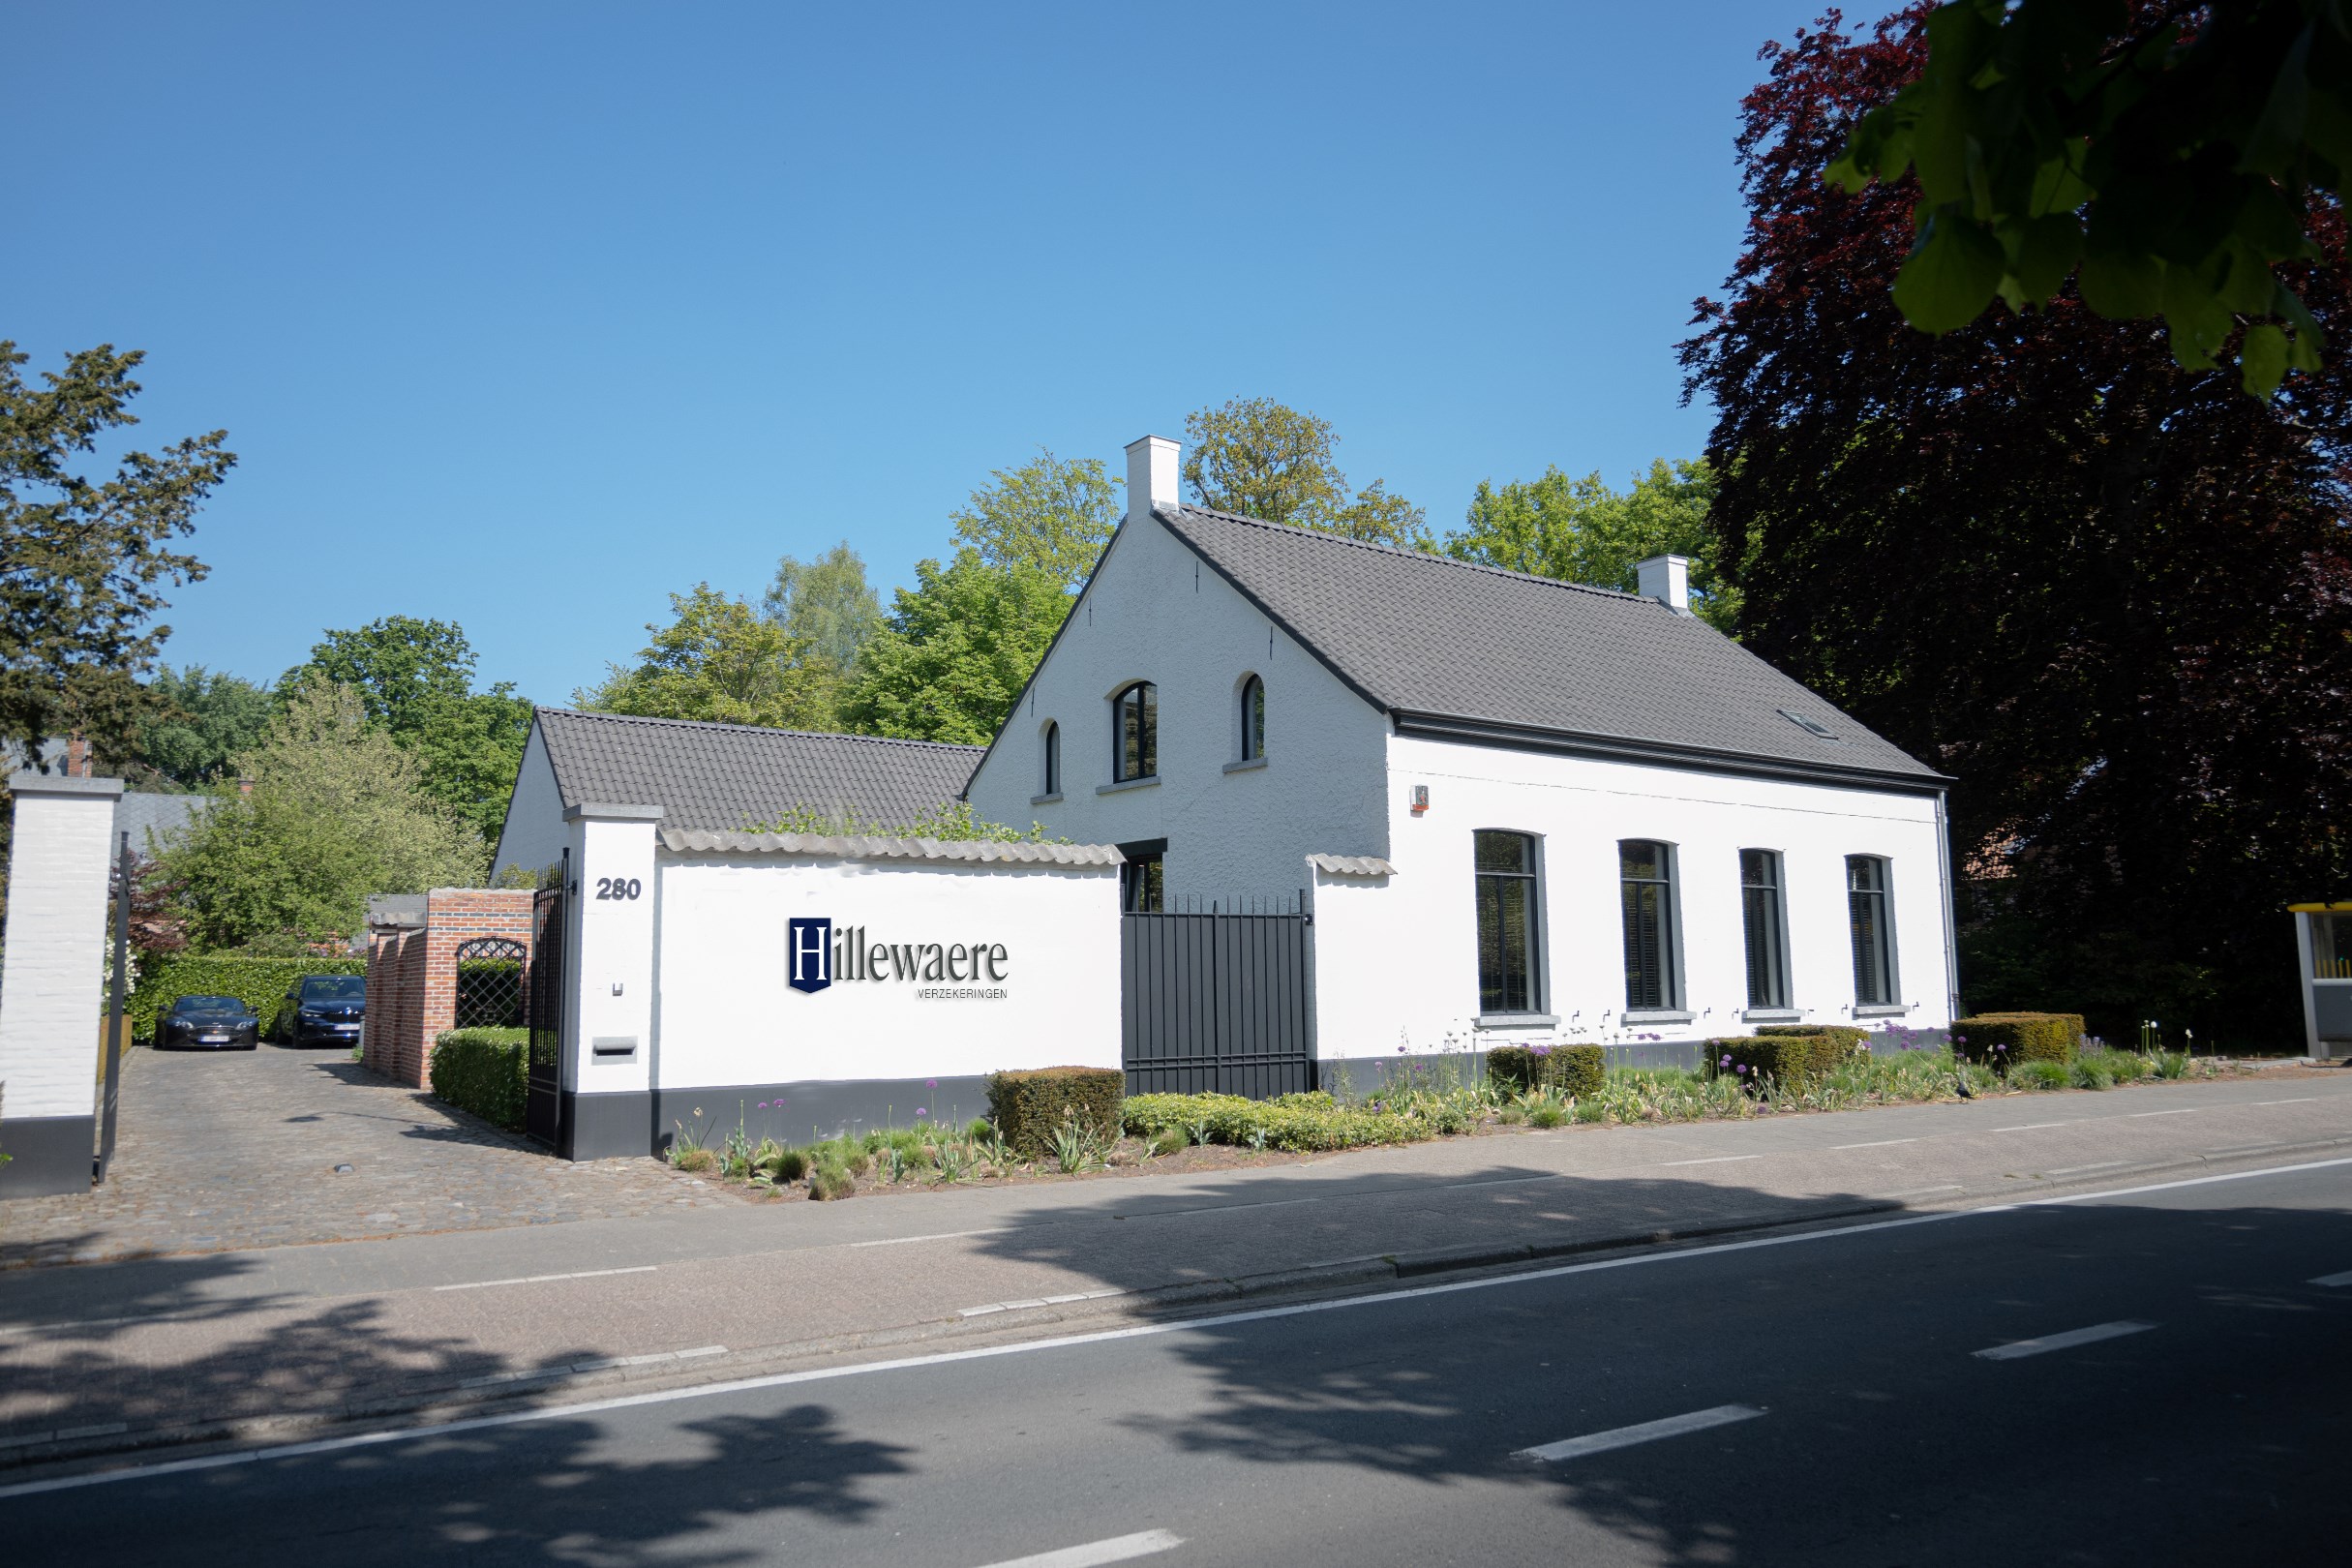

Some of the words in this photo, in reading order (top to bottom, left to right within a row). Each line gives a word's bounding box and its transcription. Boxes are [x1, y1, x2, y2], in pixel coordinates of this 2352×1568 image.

[596, 878, 641, 900] 280
[794, 925, 1009, 981] Hillewaere
[919, 988, 1008, 999] VERZEKERINGEN
